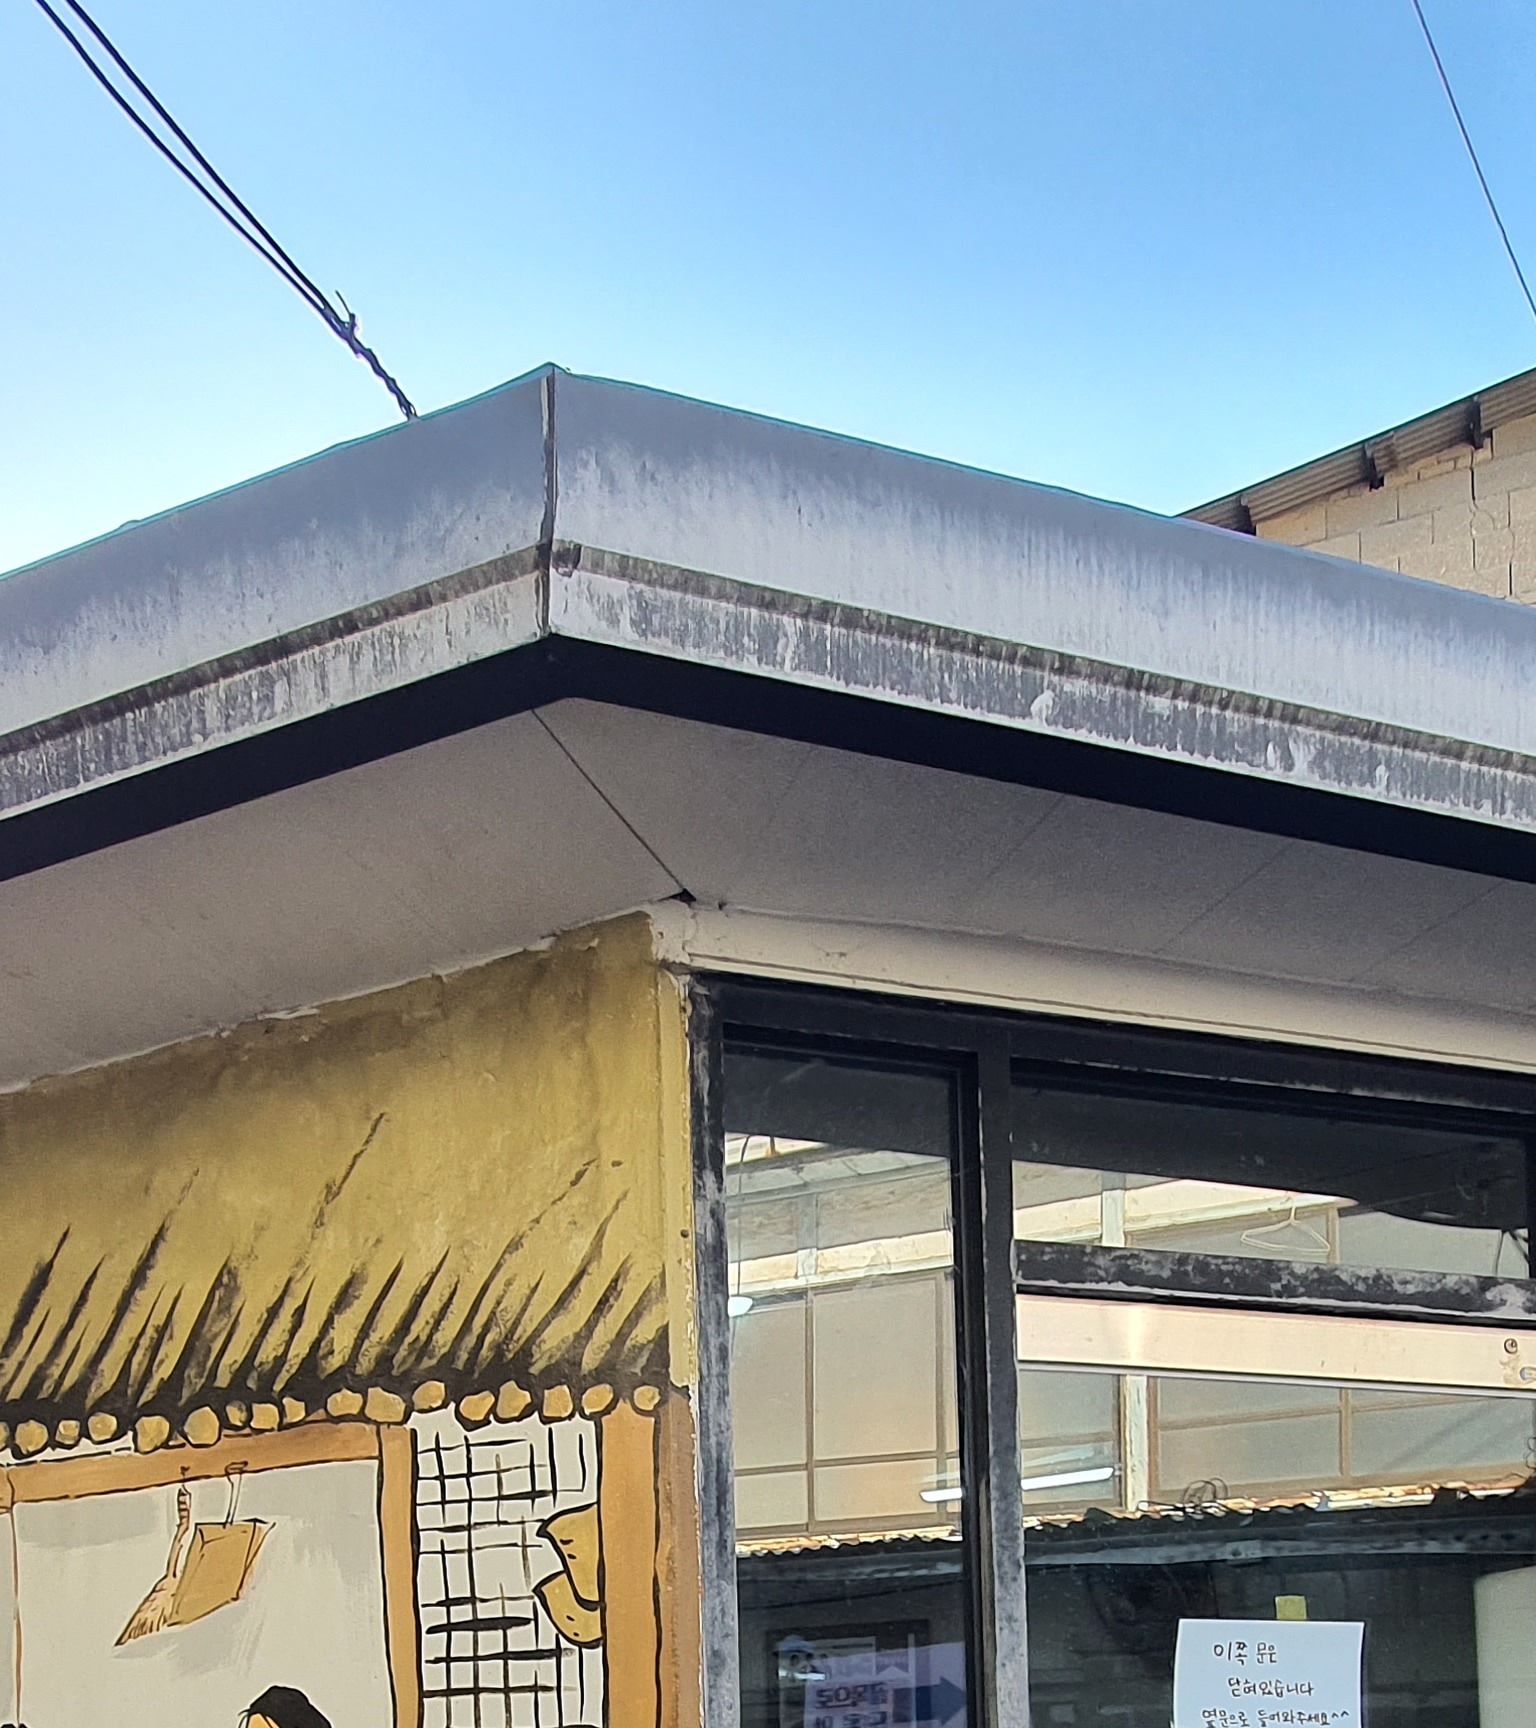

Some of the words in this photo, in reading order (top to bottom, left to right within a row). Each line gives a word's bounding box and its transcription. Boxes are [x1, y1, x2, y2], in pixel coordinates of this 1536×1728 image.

[1213, 1641, 1248, 1666] 이쪽
[1256, 1641, 1277, 1664] 문은
[1227, 1677, 1314, 1698] 닫혀있습니다
[1202, 1708, 1250, 1728] 옆문으로
